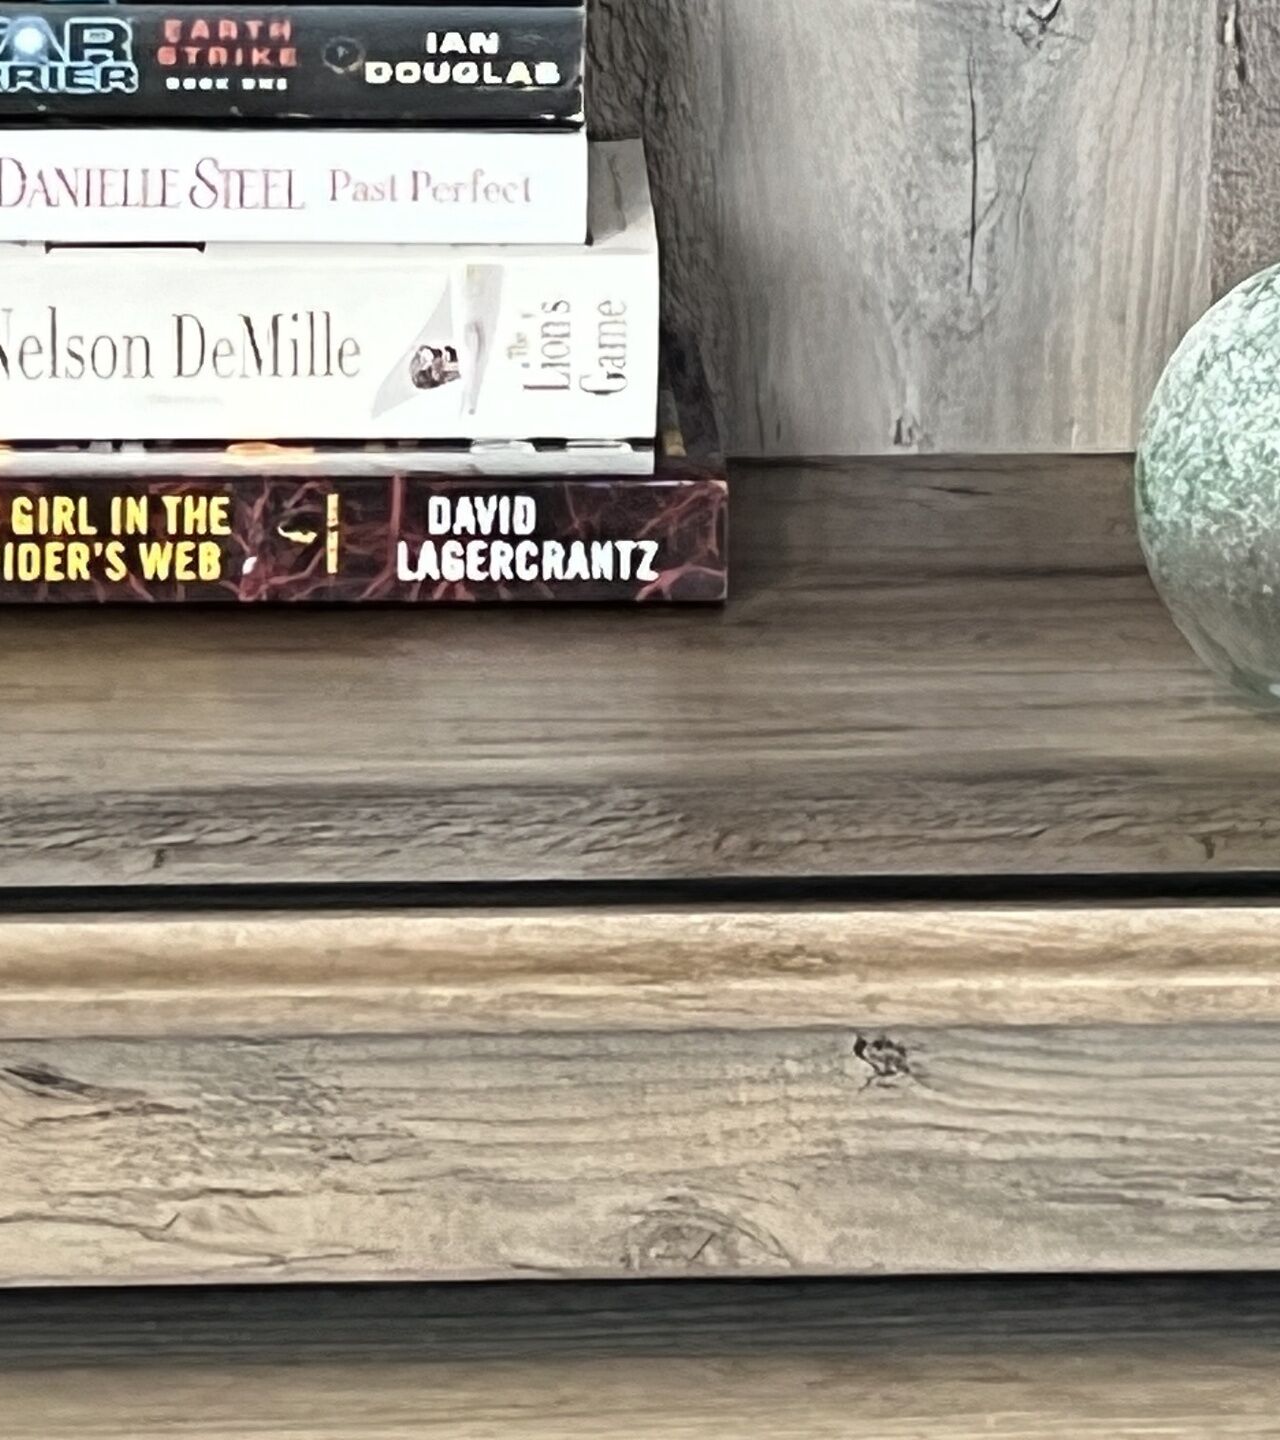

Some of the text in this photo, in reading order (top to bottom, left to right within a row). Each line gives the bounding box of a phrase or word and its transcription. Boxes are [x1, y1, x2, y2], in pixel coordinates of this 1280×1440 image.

[163, 18, 293, 44] EARTH
[424, 30, 500, 56] IAN
[363, 60, 561, 86] DOUGLAS
[188, 156, 307, 211] STEEL
[329, 167, 534, 205] Past Perfect
[171, 308, 362, 380] DeMille
[520, 299, 572, 392] Lion's
[577, 298, 629, 395] Game
[10, 495, 99, 536] GIRL
[109, 495, 149, 536] IN
[160, 495, 232, 536] THE
[427, 495, 537, 537] DAVID
[138, 541, 222, 582] WEB
[396, 539, 661, 583] LAGERCRANTZ
